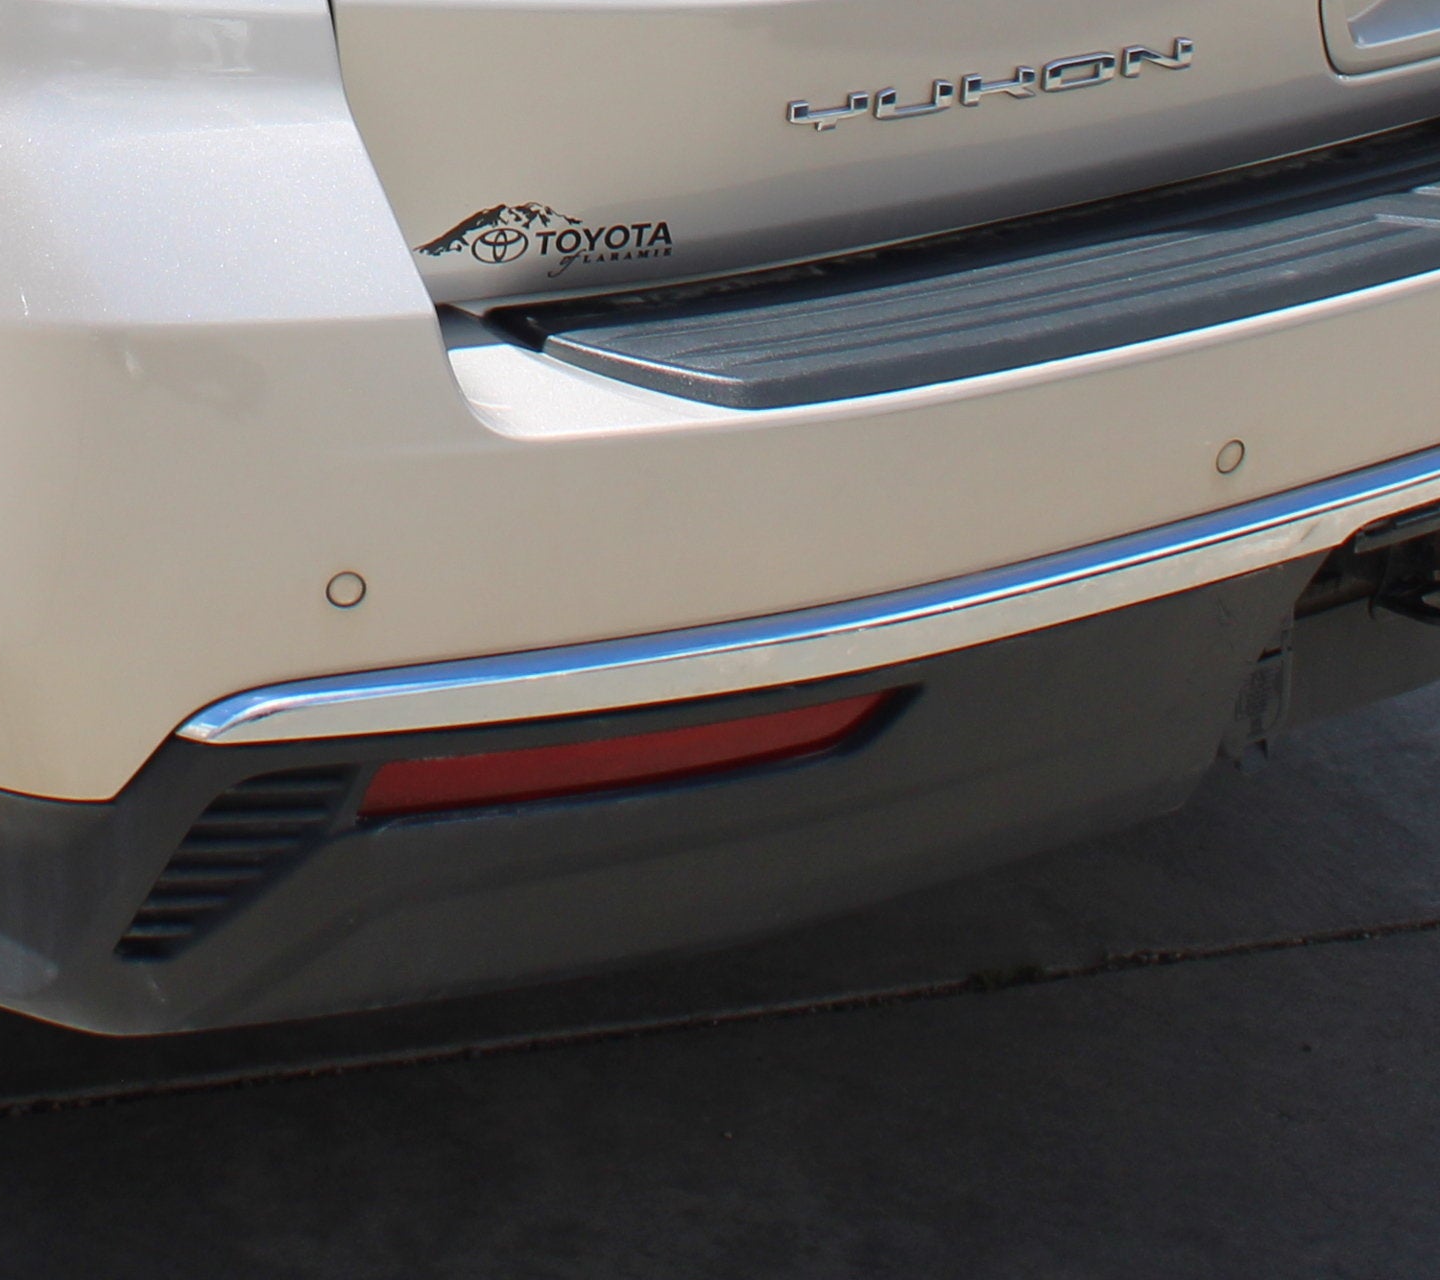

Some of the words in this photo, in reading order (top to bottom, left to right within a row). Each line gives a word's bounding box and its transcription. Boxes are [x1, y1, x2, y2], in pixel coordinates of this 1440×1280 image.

[788, 36, 1193, 132] YUKON
[536, 221, 673, 255] TOYOTA
[583, 247, 672, 264] LARAMIE
